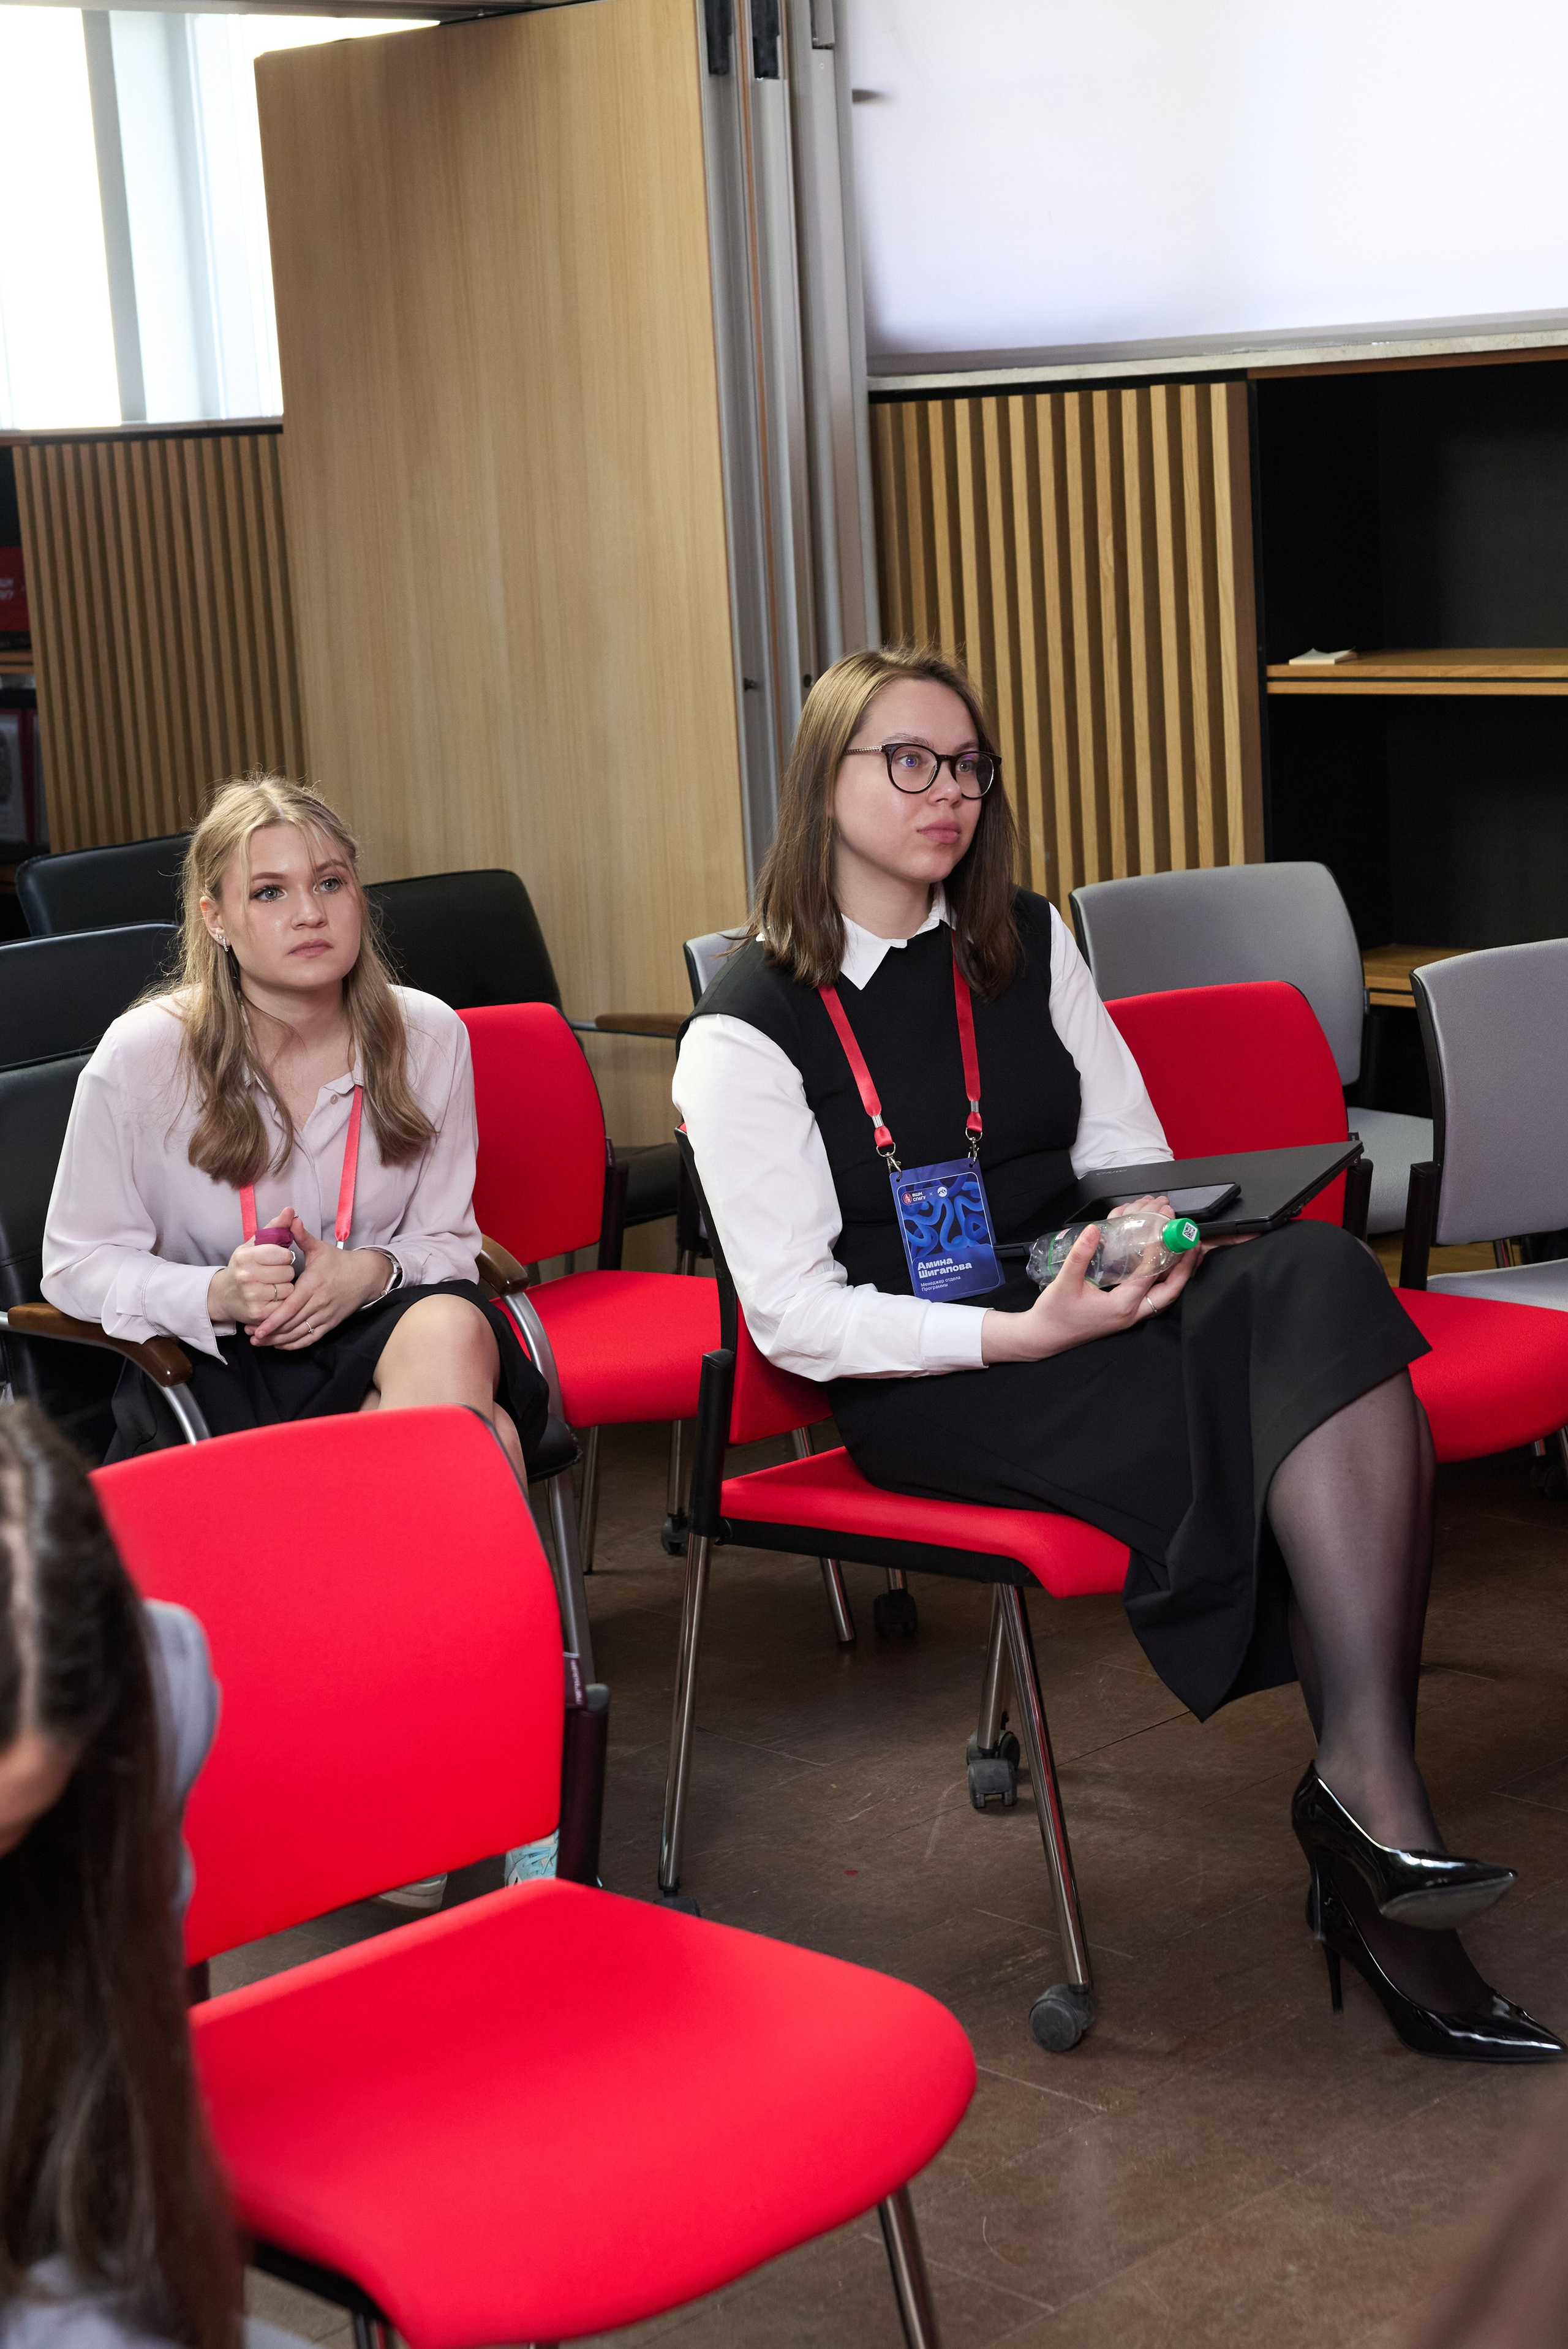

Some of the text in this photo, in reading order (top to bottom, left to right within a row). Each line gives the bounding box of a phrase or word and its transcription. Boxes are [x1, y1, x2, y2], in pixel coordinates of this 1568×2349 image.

[918, 1257, 954, 1270] Амина
[918, 1262, 973, 1278] Шигапова
[922, 1283, 948, 1292] Программы
